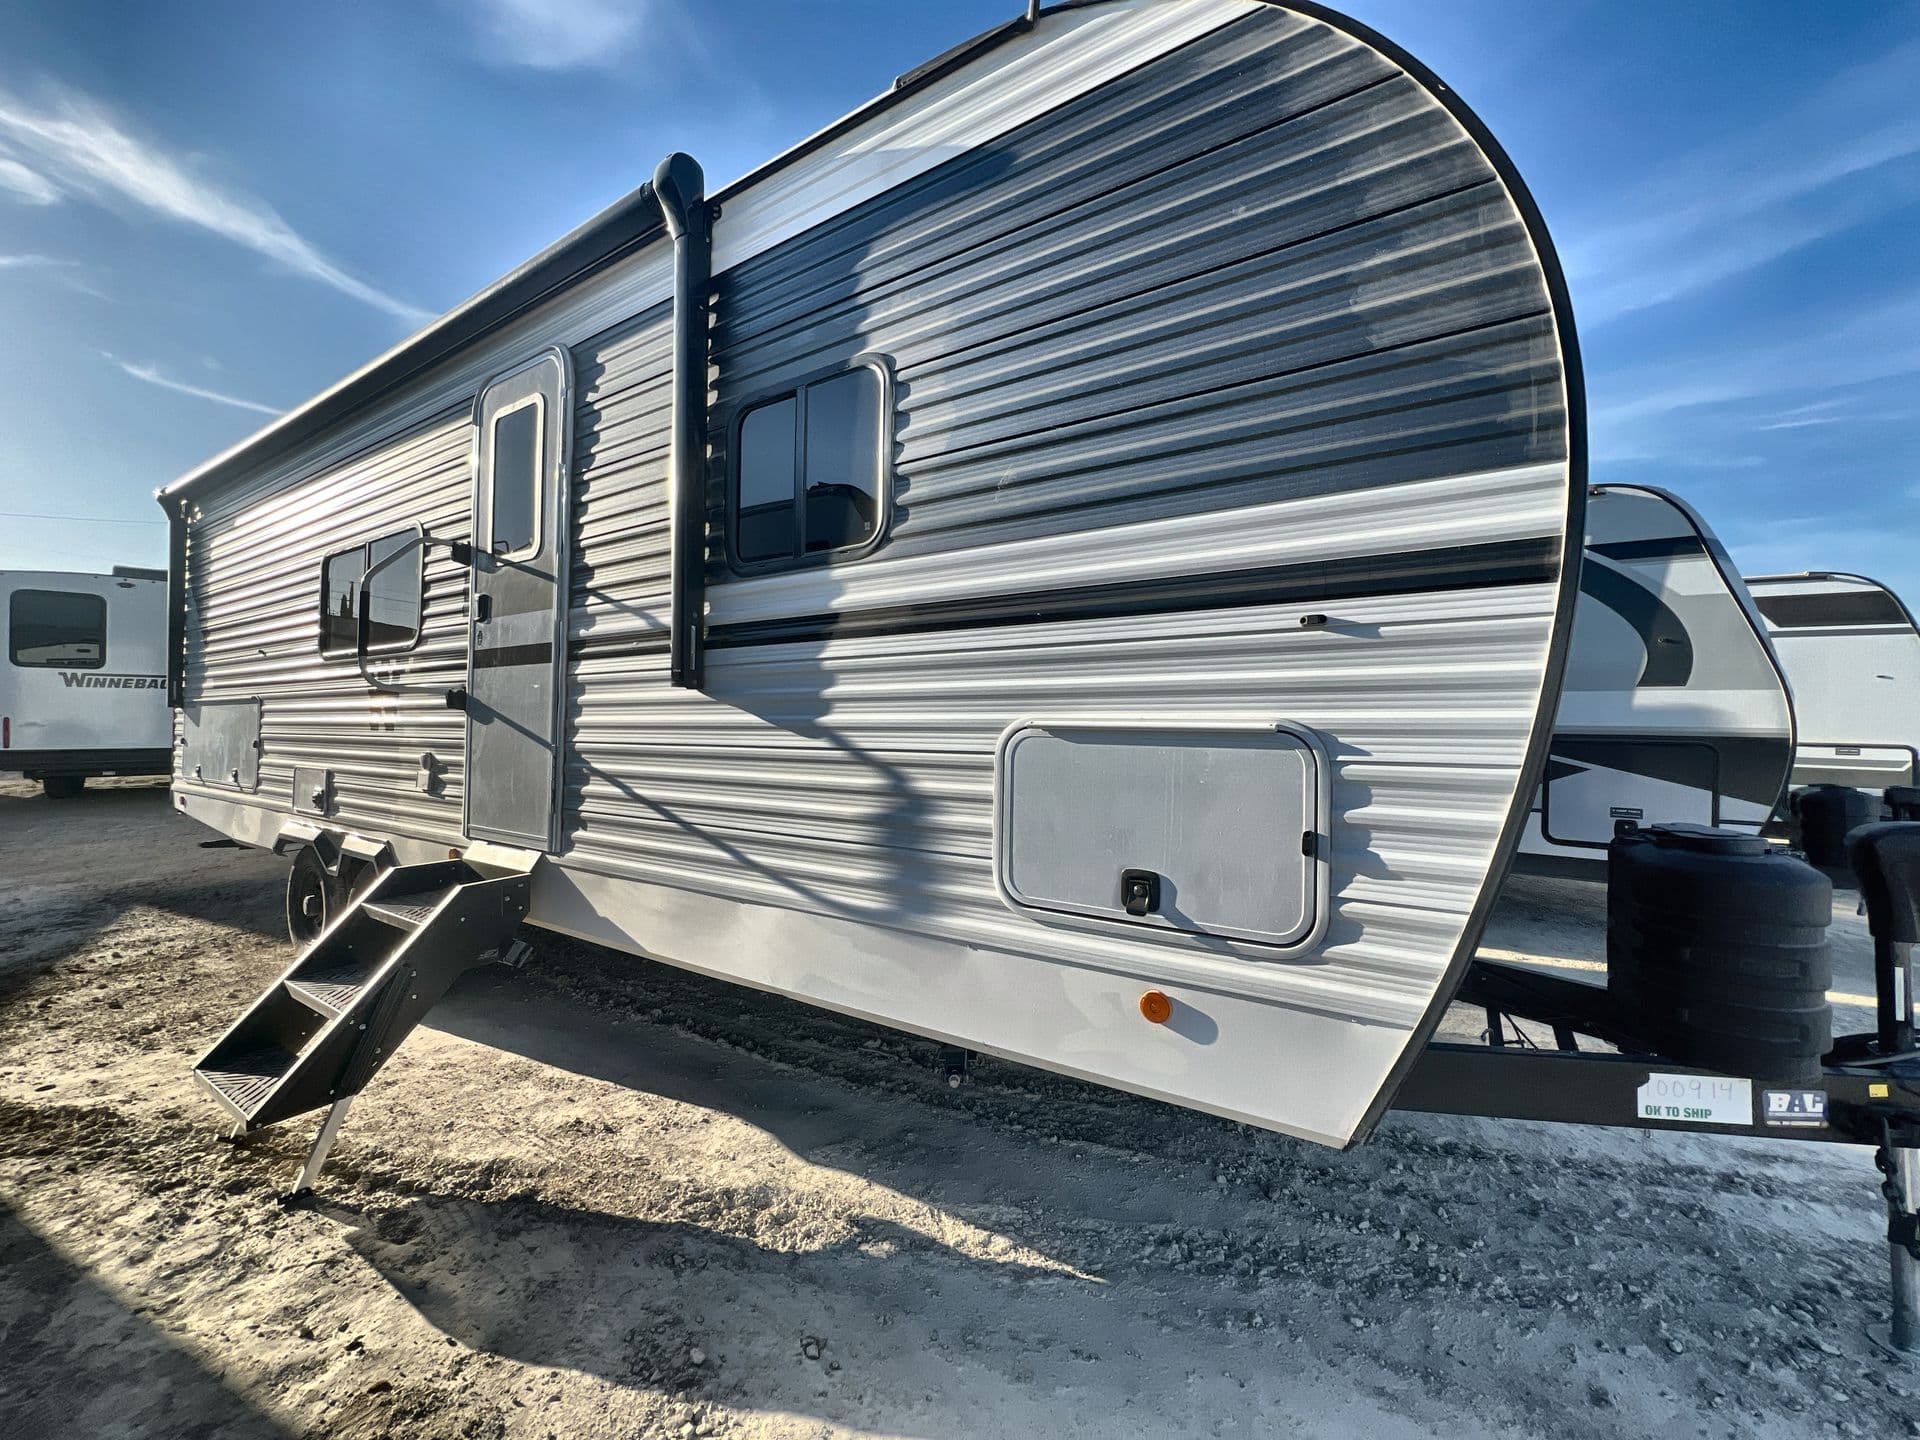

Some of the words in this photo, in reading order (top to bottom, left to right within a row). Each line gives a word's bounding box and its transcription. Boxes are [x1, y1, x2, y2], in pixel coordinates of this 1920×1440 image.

[1645, 1104, 1661, 1116] OK
[1665, 1106, 1680, 1117] TO
[1683, 1107, 1713, 1119] SHIP
